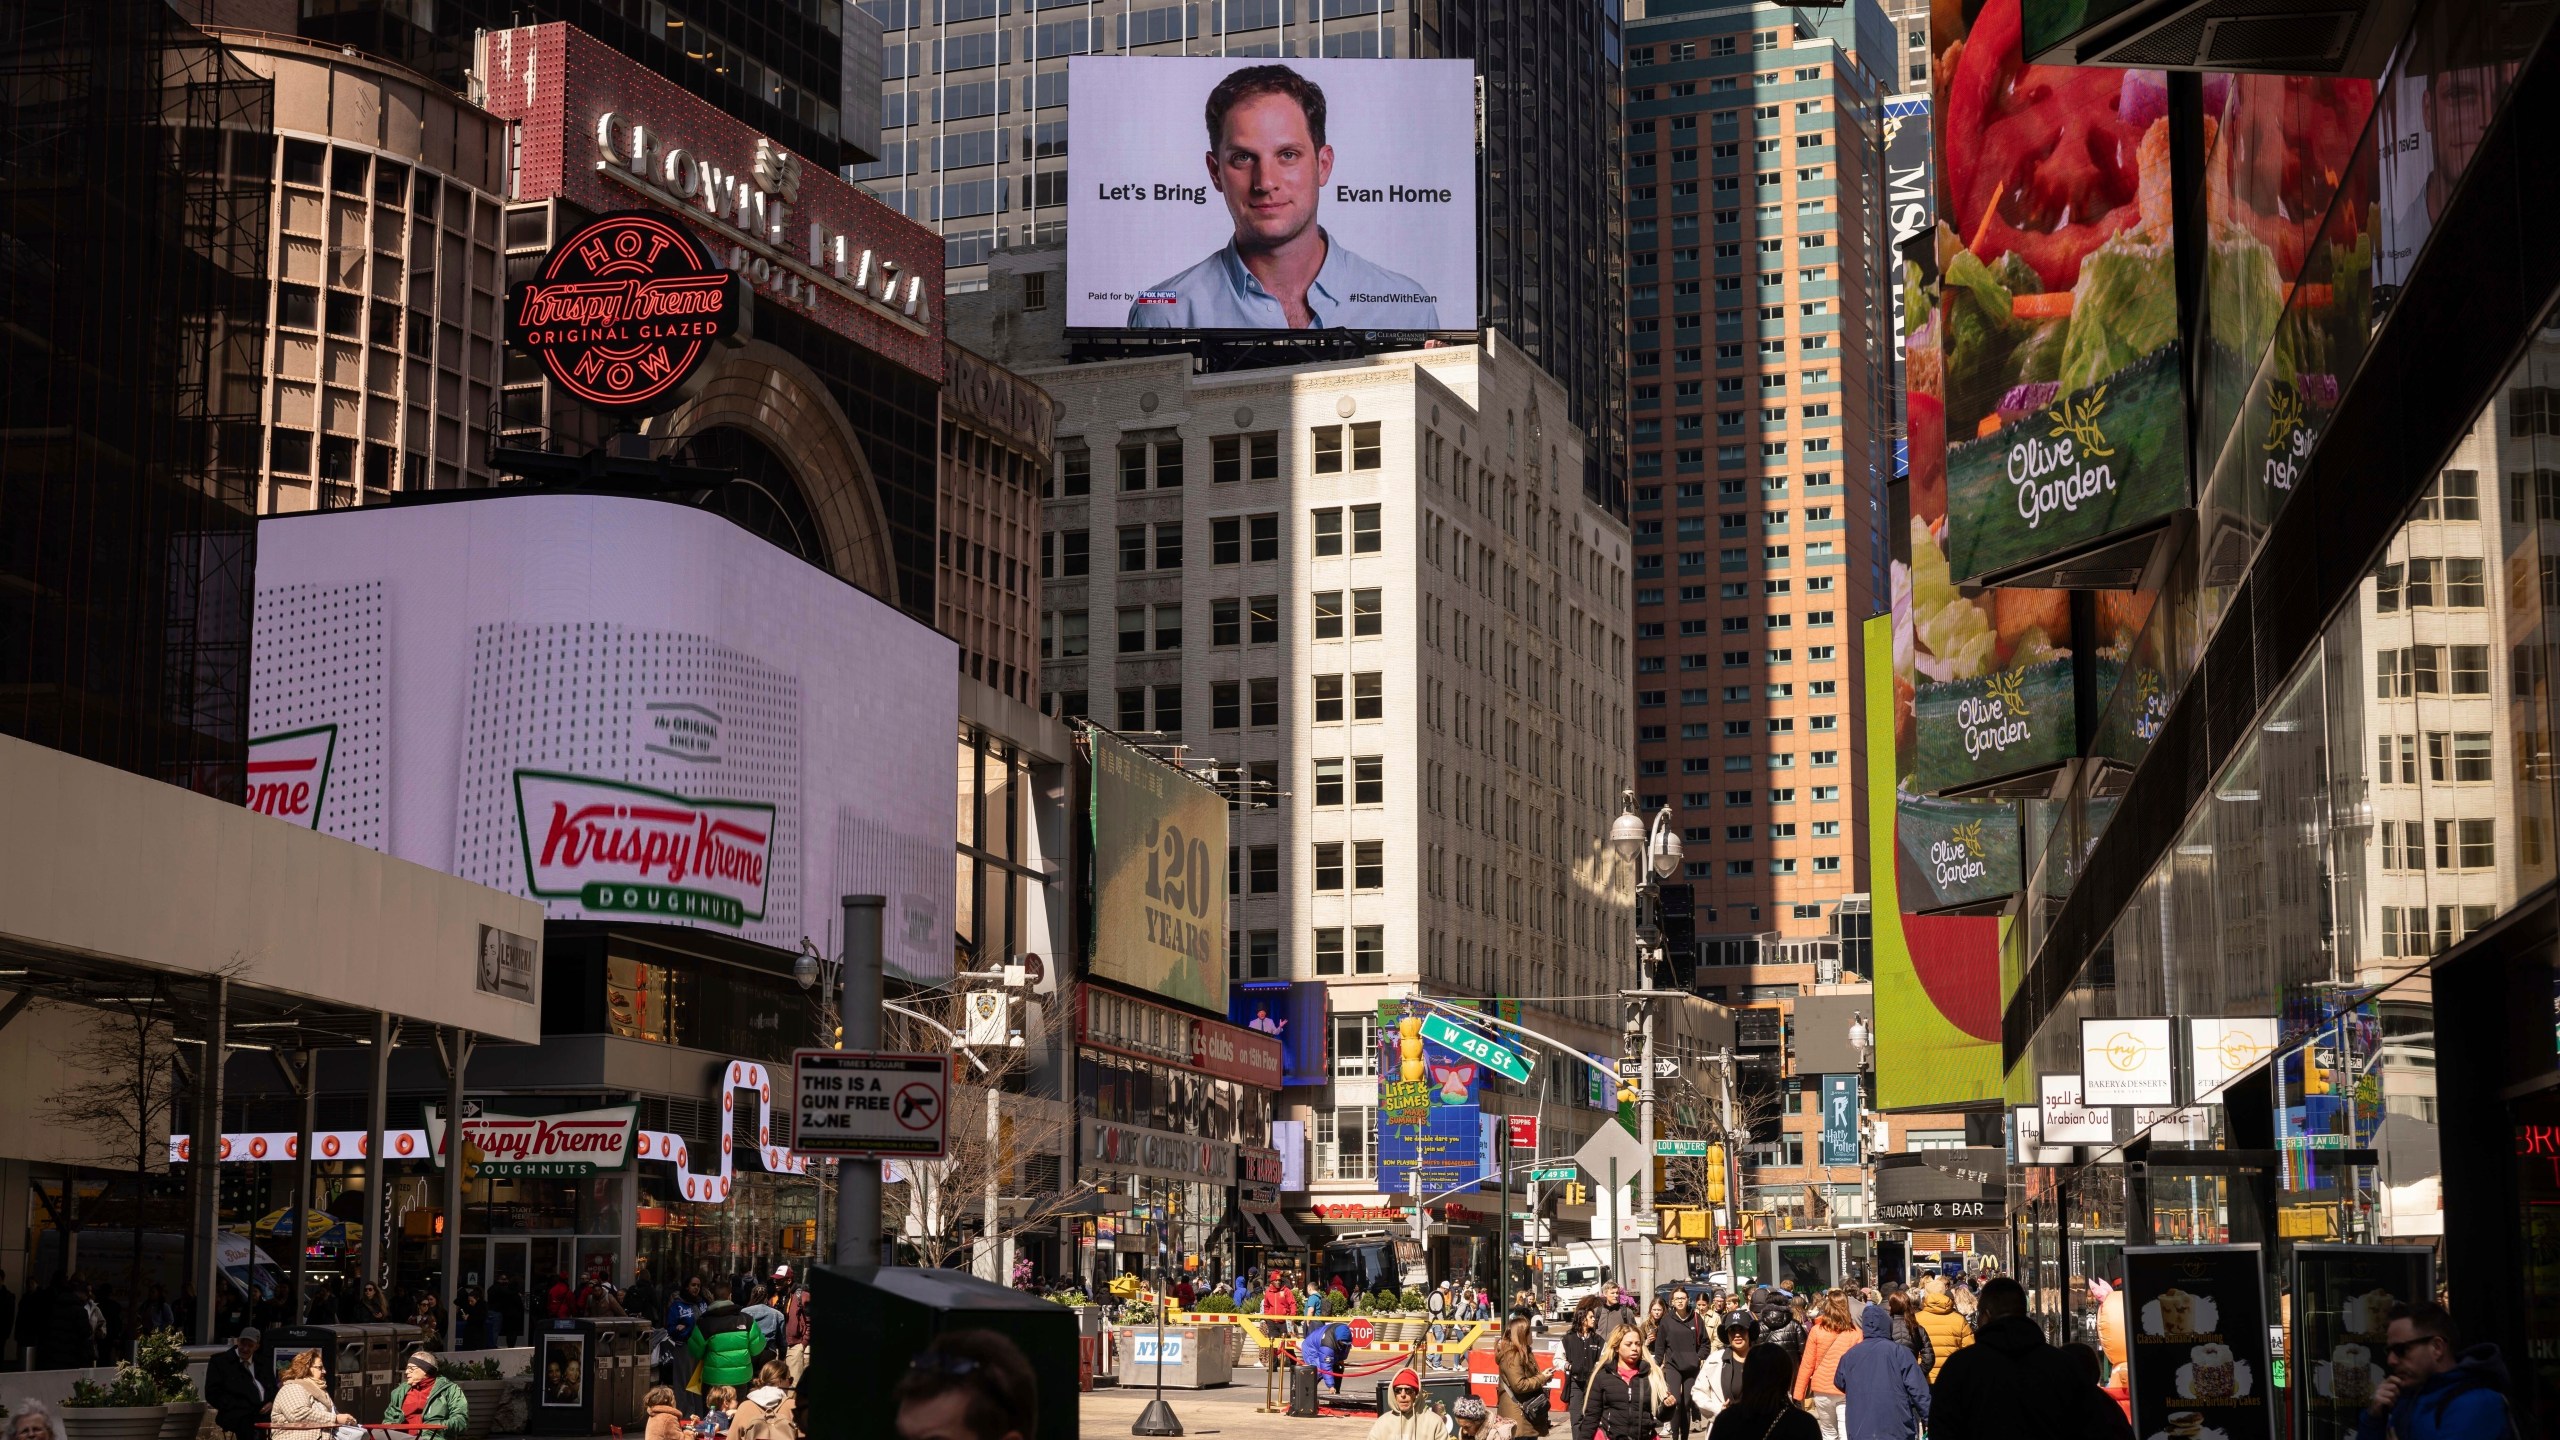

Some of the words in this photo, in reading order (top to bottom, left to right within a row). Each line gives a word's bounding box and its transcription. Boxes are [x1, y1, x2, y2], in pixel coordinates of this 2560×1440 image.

[1099, 183, 1147, 201] Let’s
[1154, 184, 1206, 204] Bring
[1337, 186, 1383, 202] Evan
[1389, 186, 1451, 202] Home
[597, 112, 795, 250] CROWNE
[810, 223, 930, 323] PLAZA
[579, 230, 669, 270] HOT
[519, 280, 628, 328] Krispy
[622, 274, 729, 320] Kreme
[1088, 292, 1108, 300] Paid
[1110, 292, 1122, 300] for
[1124, 293, 1135, 302] by
[1349, 293, 1437, 303] #IStandWithEvan
[528, 327, 629, 344] ORIGINAL
[640, 321, 718, 338] GLAZED
[574, 346, 670, 391] NOW
[2007, 437, 2074, 485] Olive
[2018, 464, 2116, 528] Garden
[1957, 697, 2003, 729] Olive
[674, 716, 718, 740] ORIGINAL
[1964, 720, 2030, 760] Garden
[540, 801, 696, 883] Krispy
[693, 812, 766, 887] Kreme
[1931, 840, 1965, 865] Olive
[1145, 818, 1210, 919] 120
[1936, 859, 1986, 889] Garden
[600, 889, 737, 922] DOUGHNUTS
[1145, 906, 1210, 964] YEARS
[1209, 1031, 1234, 1062] clubs
[1240, 1048, 1248, 1063] on
[1444, 1027, 1459, 1041] W
[1462, 1039, 1489, 1056] 48
[1491, 1053, 1512, 1070] St
[838, 1059, 866, 1068] TIMES
[869, 1060, 905, 1069] SQUARE
[803, 1077, 842, 1090] THIS
[848, 1077, 864, 1090] IS
[870, 1078, 881, 1091] A
[1417, 1082, 1428, 1093] &
[802, 1095, 838, 1109] GUN
[845, 1097, 890, 1110] FREE
[2047, 1111, 2085, 1125] Arabian
[2089, 1110, 2109, 1124] Oud
[532, 1120, 627, 1155] Kreme
[1658, 1142, 1671, 1150] LOU
[1674, 1142, 1706, 1150] WALTERS
[1826, 1129, 1848, 1143] Harry
[1424, 1145, 1436, 1154] join
[1834, 1141, 1856, 1155] Potter
[1246, 1157, 1256, 1180] THE
[1327, 1204, 1363, 1218] CVS
[1878, 1203, 1925, 1218] ESTAURANT
[1934, 1203, 1942, 1216] &
[1952, 1203, 1984, 1216] BAR
[1136, 1341, 1180, 1356] NYPD
[2136, 1333, 2163, 1344] Classic
[2164, 1333, 2192, 1344] Banana
[2193, 1333, 2224, 1344] Pudding
[1483, 1375, 1500, 1383] TIM
[2166, 1396, 2205, 1407] Handmade
[2207, 1396, 2238, 1408] Birthday
[2240, 1396, 2262, 1406] Cakes
